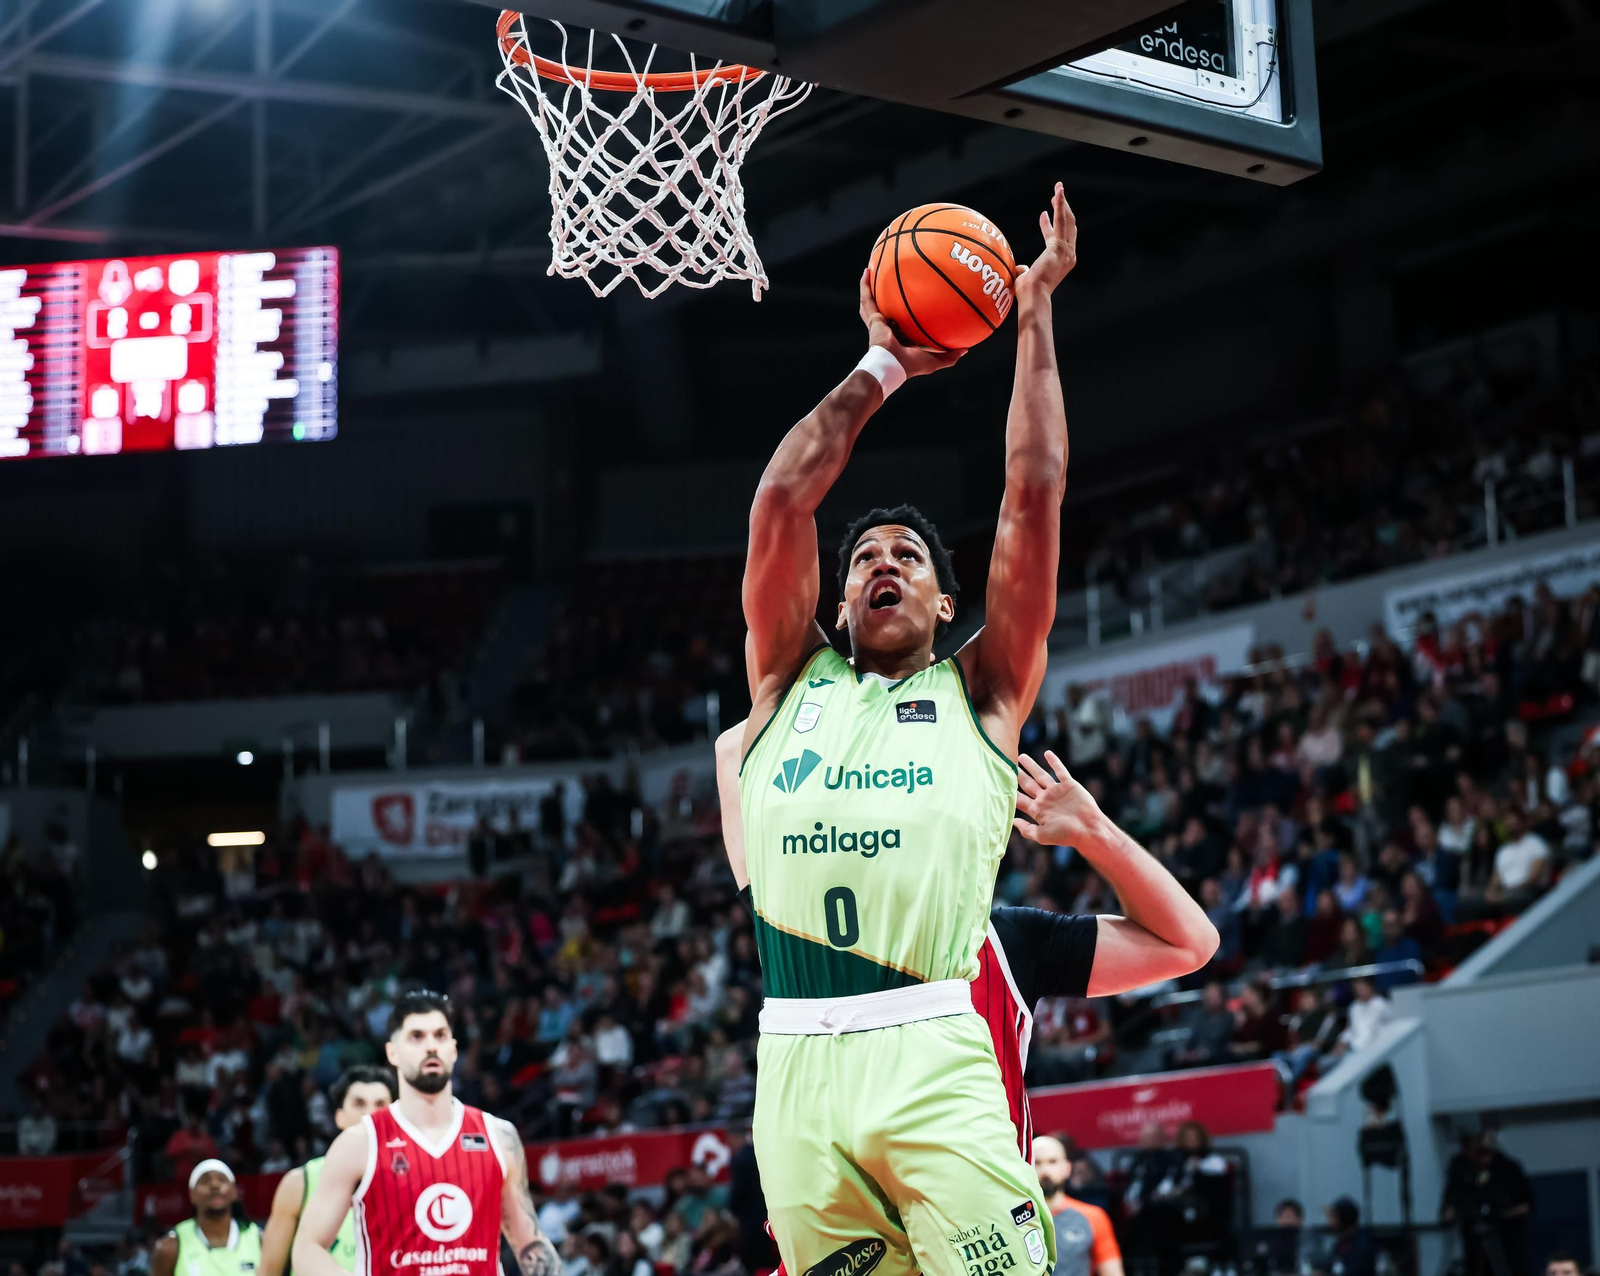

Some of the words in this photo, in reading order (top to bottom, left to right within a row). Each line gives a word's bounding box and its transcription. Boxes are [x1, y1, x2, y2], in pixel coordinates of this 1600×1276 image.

[1140, 34, 1224, 72] endesa
[950, 240, 1013, 319] Wilson
[899, 707, 916, 715] liga
[900, 713, 935, 721] endesa
[824, 761, 933, 793] Unicaja
[824, 886, 860, 948] 0
[1015, 1210, 1032, 1224] acb
[948, 1224, 981, 1246] sabor
[962, 1252, 1018, 1276] aga
